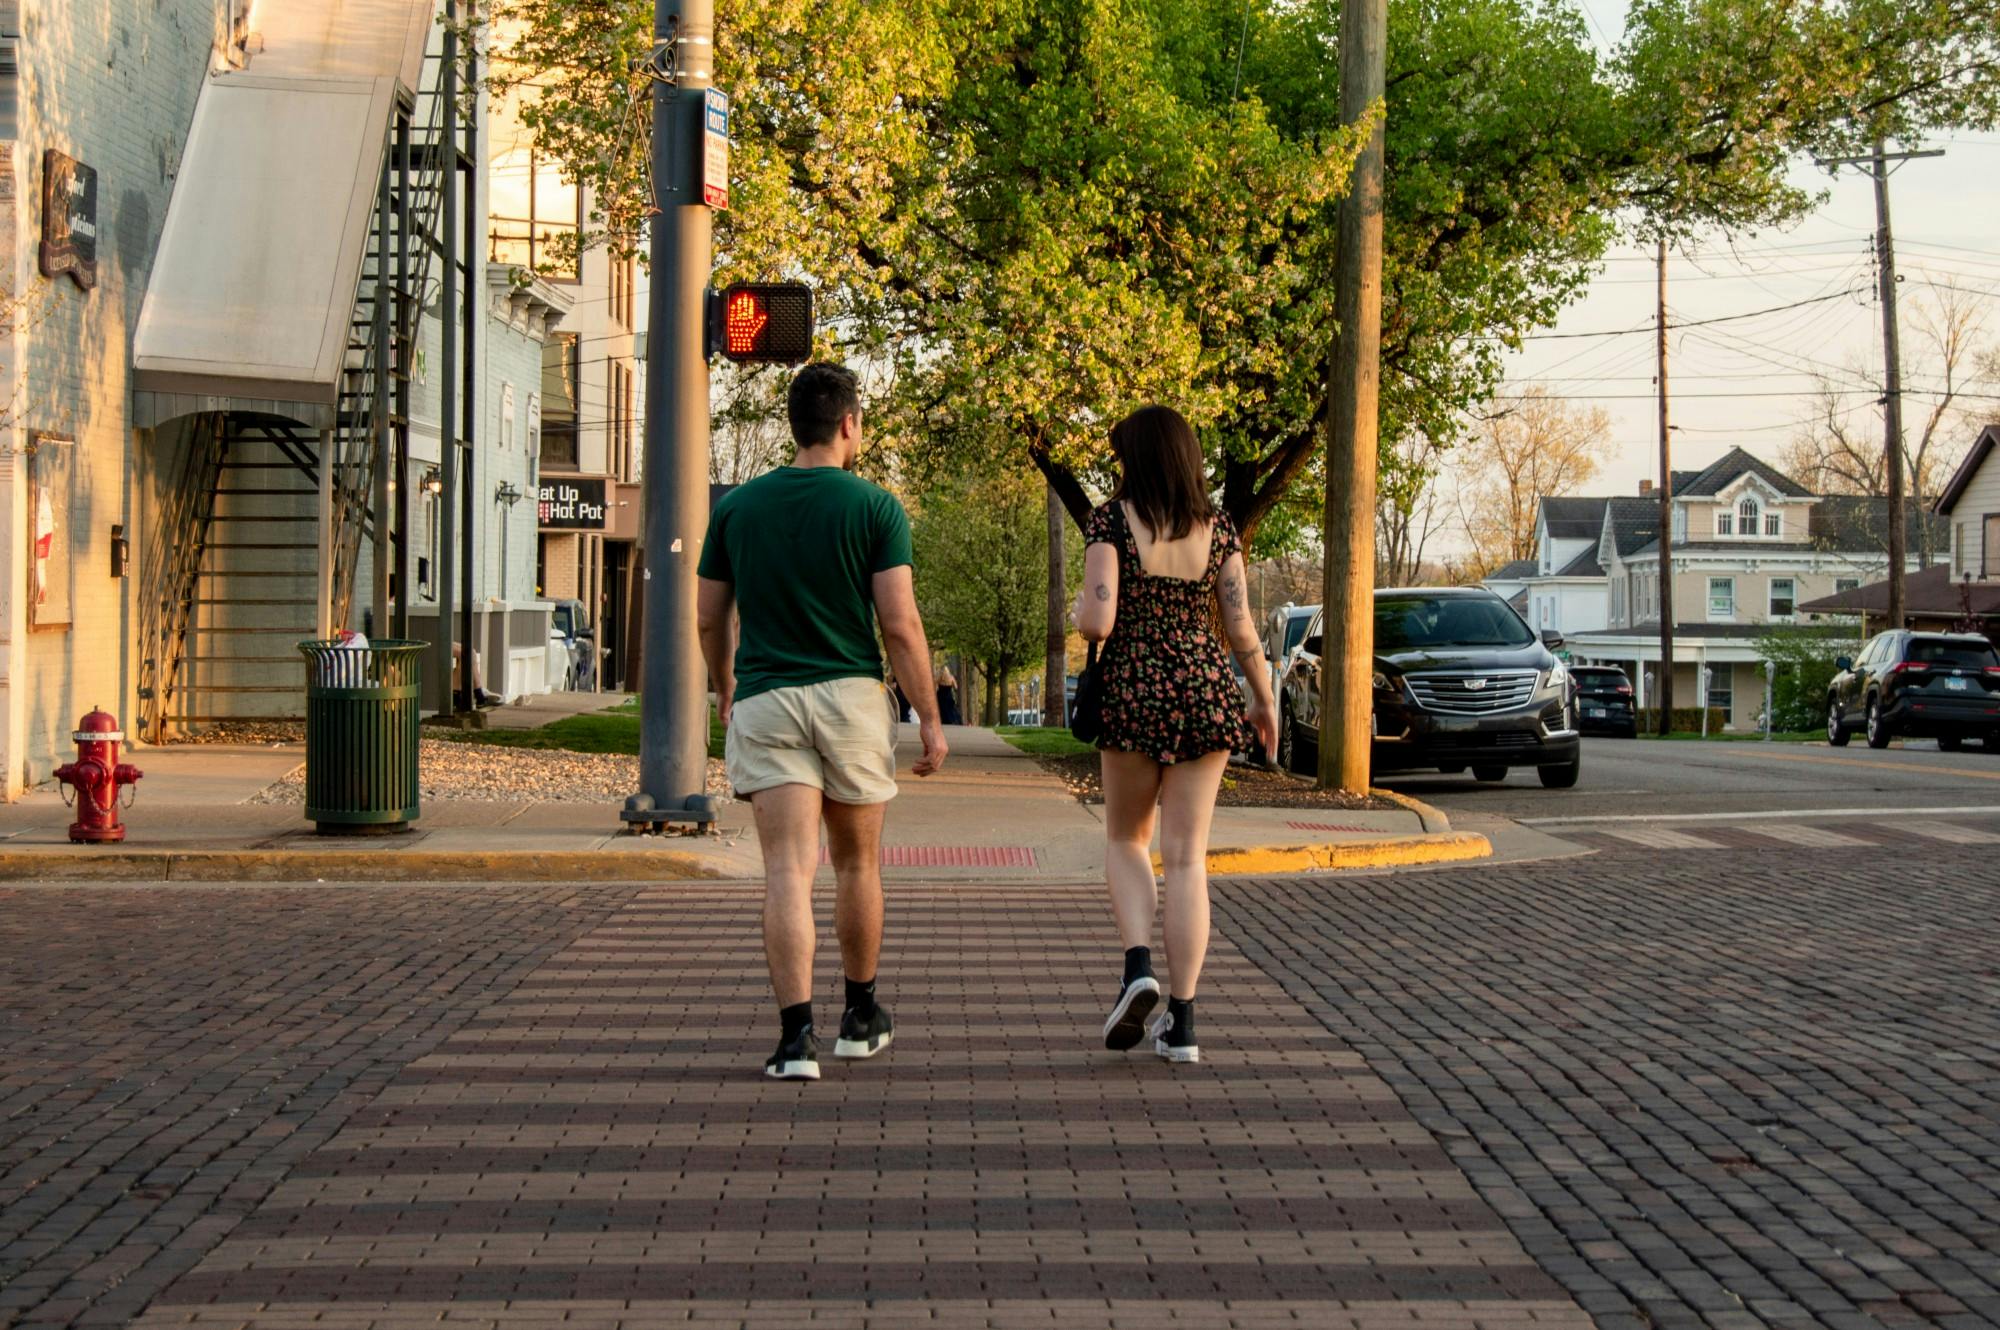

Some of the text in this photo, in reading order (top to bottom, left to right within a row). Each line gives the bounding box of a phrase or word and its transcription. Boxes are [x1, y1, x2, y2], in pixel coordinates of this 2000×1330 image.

[539, 485, 579, 504] at Up
[550, 502, 603, 520] Hot Pot
